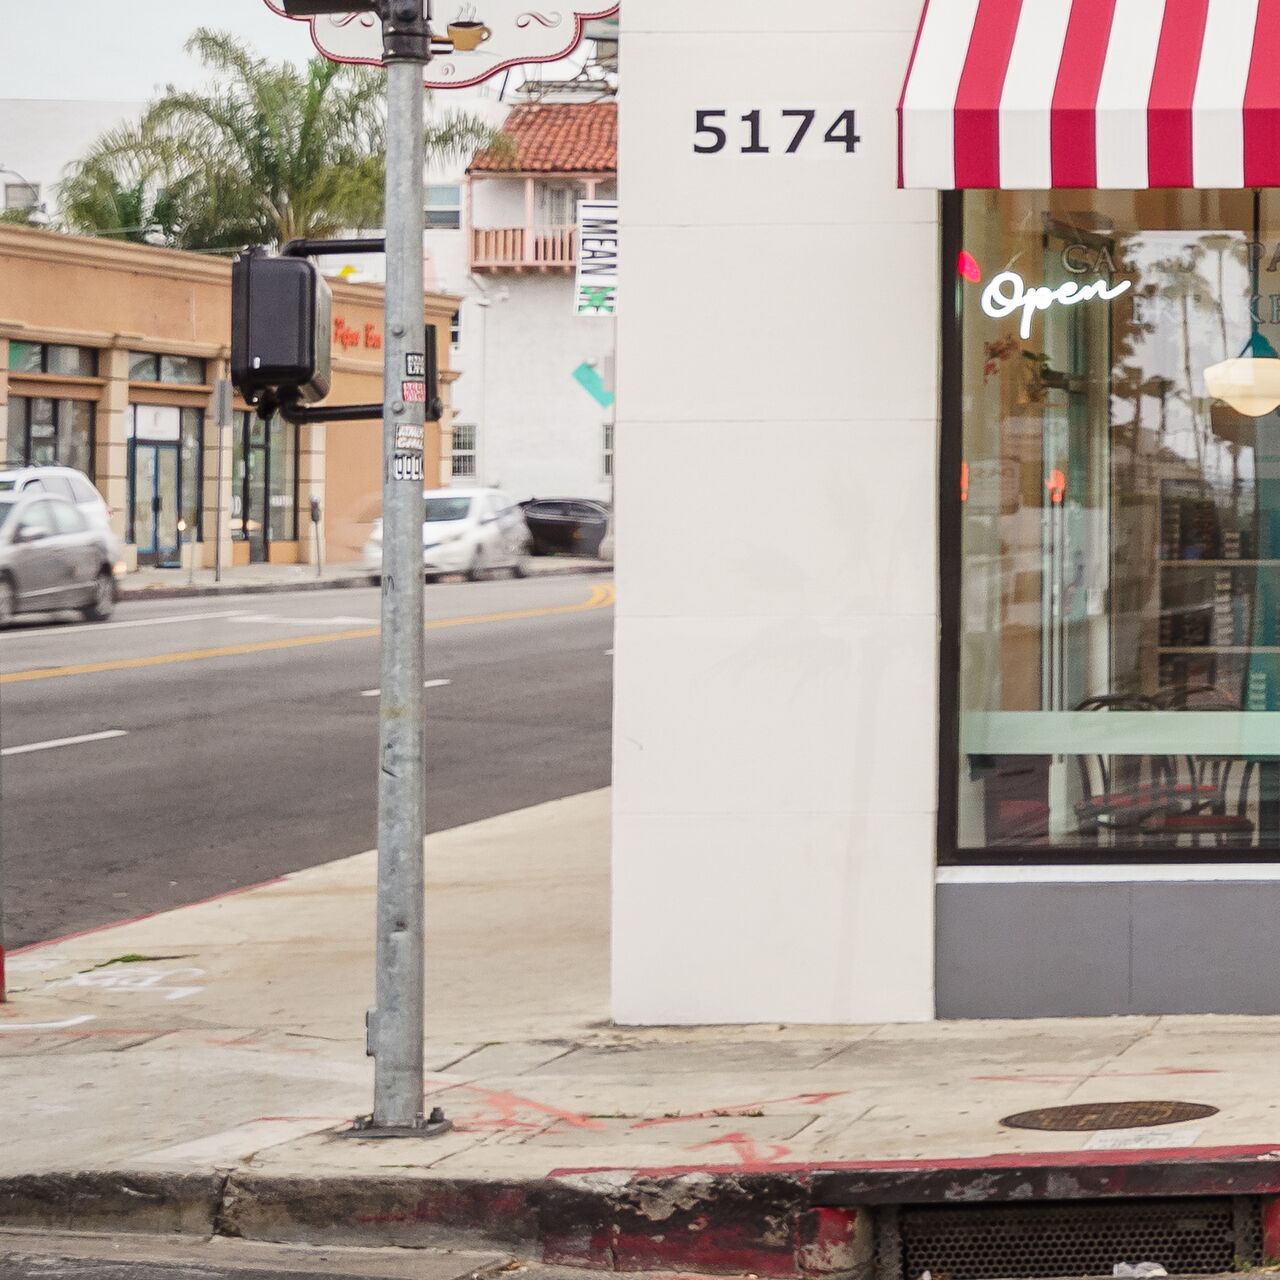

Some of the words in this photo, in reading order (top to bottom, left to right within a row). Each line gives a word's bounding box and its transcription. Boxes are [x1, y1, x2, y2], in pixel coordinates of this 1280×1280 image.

[693, 109, 861, 153] 5174
[581, 218, 618, 276] MEAN
[980, 270, 1133, 340] Open
